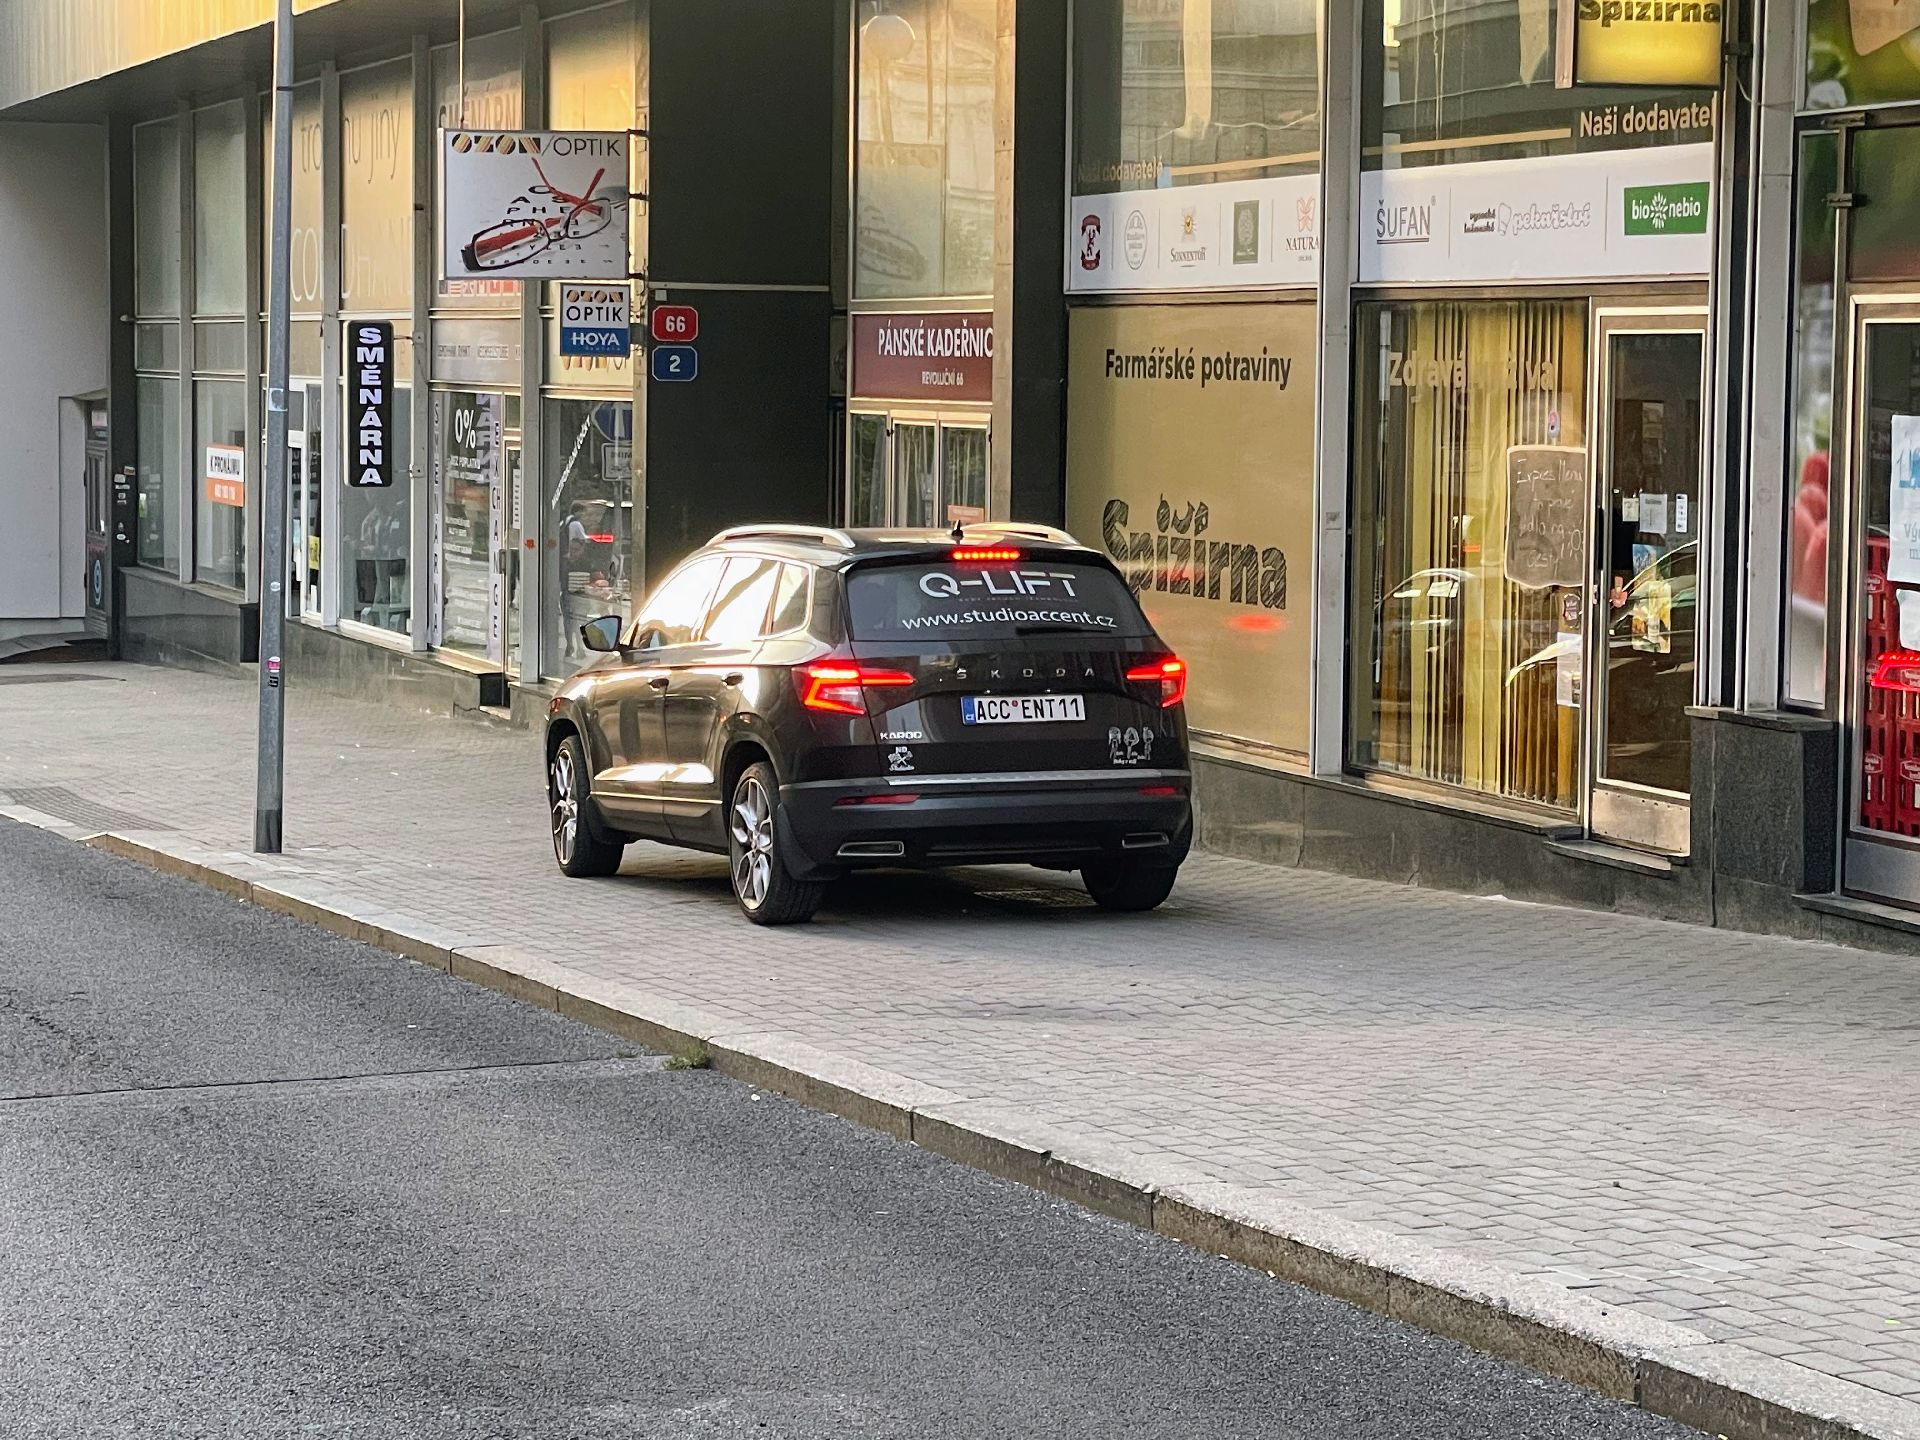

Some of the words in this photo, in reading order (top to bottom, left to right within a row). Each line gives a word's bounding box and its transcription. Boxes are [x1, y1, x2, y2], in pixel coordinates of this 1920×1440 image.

[1580, 106, 1618, 138] Naši
[1377, 199, 1430, 238] ŠUFAN
[1632, 199, 1650, 219] bio
[1669, 197, 1701, 217] nebio
[566, 289, 623, 303] OZON
[566, 306, 622, 322] OPTIK
[666, 315, 686, 333] 66
[571, 332, 621, 346] HOYA
[878, 320, 924, 356] PÁNSKÉ
[927, 319, 993, 358] KADEŘNIC
[669, 354, 681, 373] 2
[1105, 347, 1195, 380] Farmářské
[1201, 346, 1291, 391] potraviny
[1389, 351, 1467, 387] Zdravá
[357, 327, 384, 484] SMĚNÁRNA
[455, 408, 476, 449] 0%
[919, 571, 1076, 598] Q-LIFT
[902, 607, 1118, 630] www.studioaccent.cz
[957, 667, 1095, 680] ŠKODA
[977, 700, 1011, 721] ACC
[1021, 698, 1080, 719] ENT11
